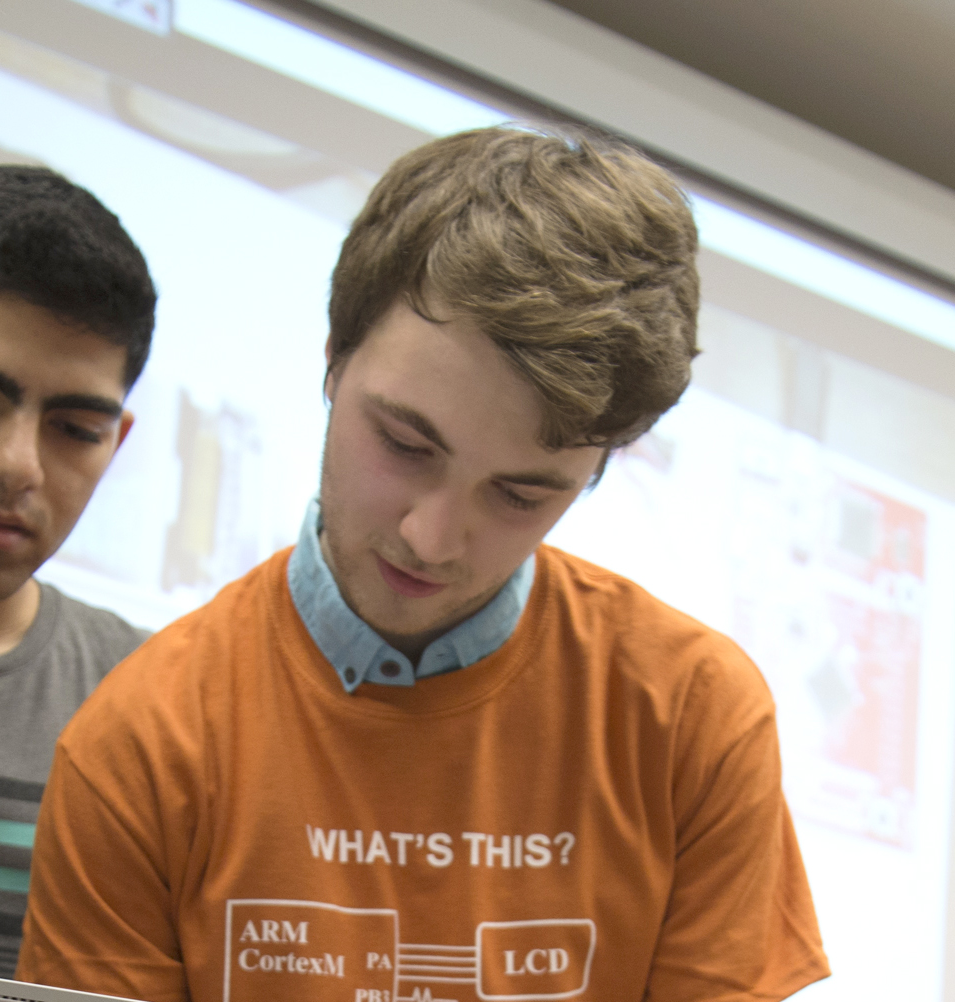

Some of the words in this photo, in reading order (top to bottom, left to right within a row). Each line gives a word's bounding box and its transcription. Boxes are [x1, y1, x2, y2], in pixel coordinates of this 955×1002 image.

[306, 824, 454, 867] WHAT'S
[462, 831, 576, 868] THIS?
[239, 919, 309, 945] ARM
[238, 948, 345, 978] CortexM
[366, 952, 392, 971] PA
[504, 948, 569, 976] LCD
